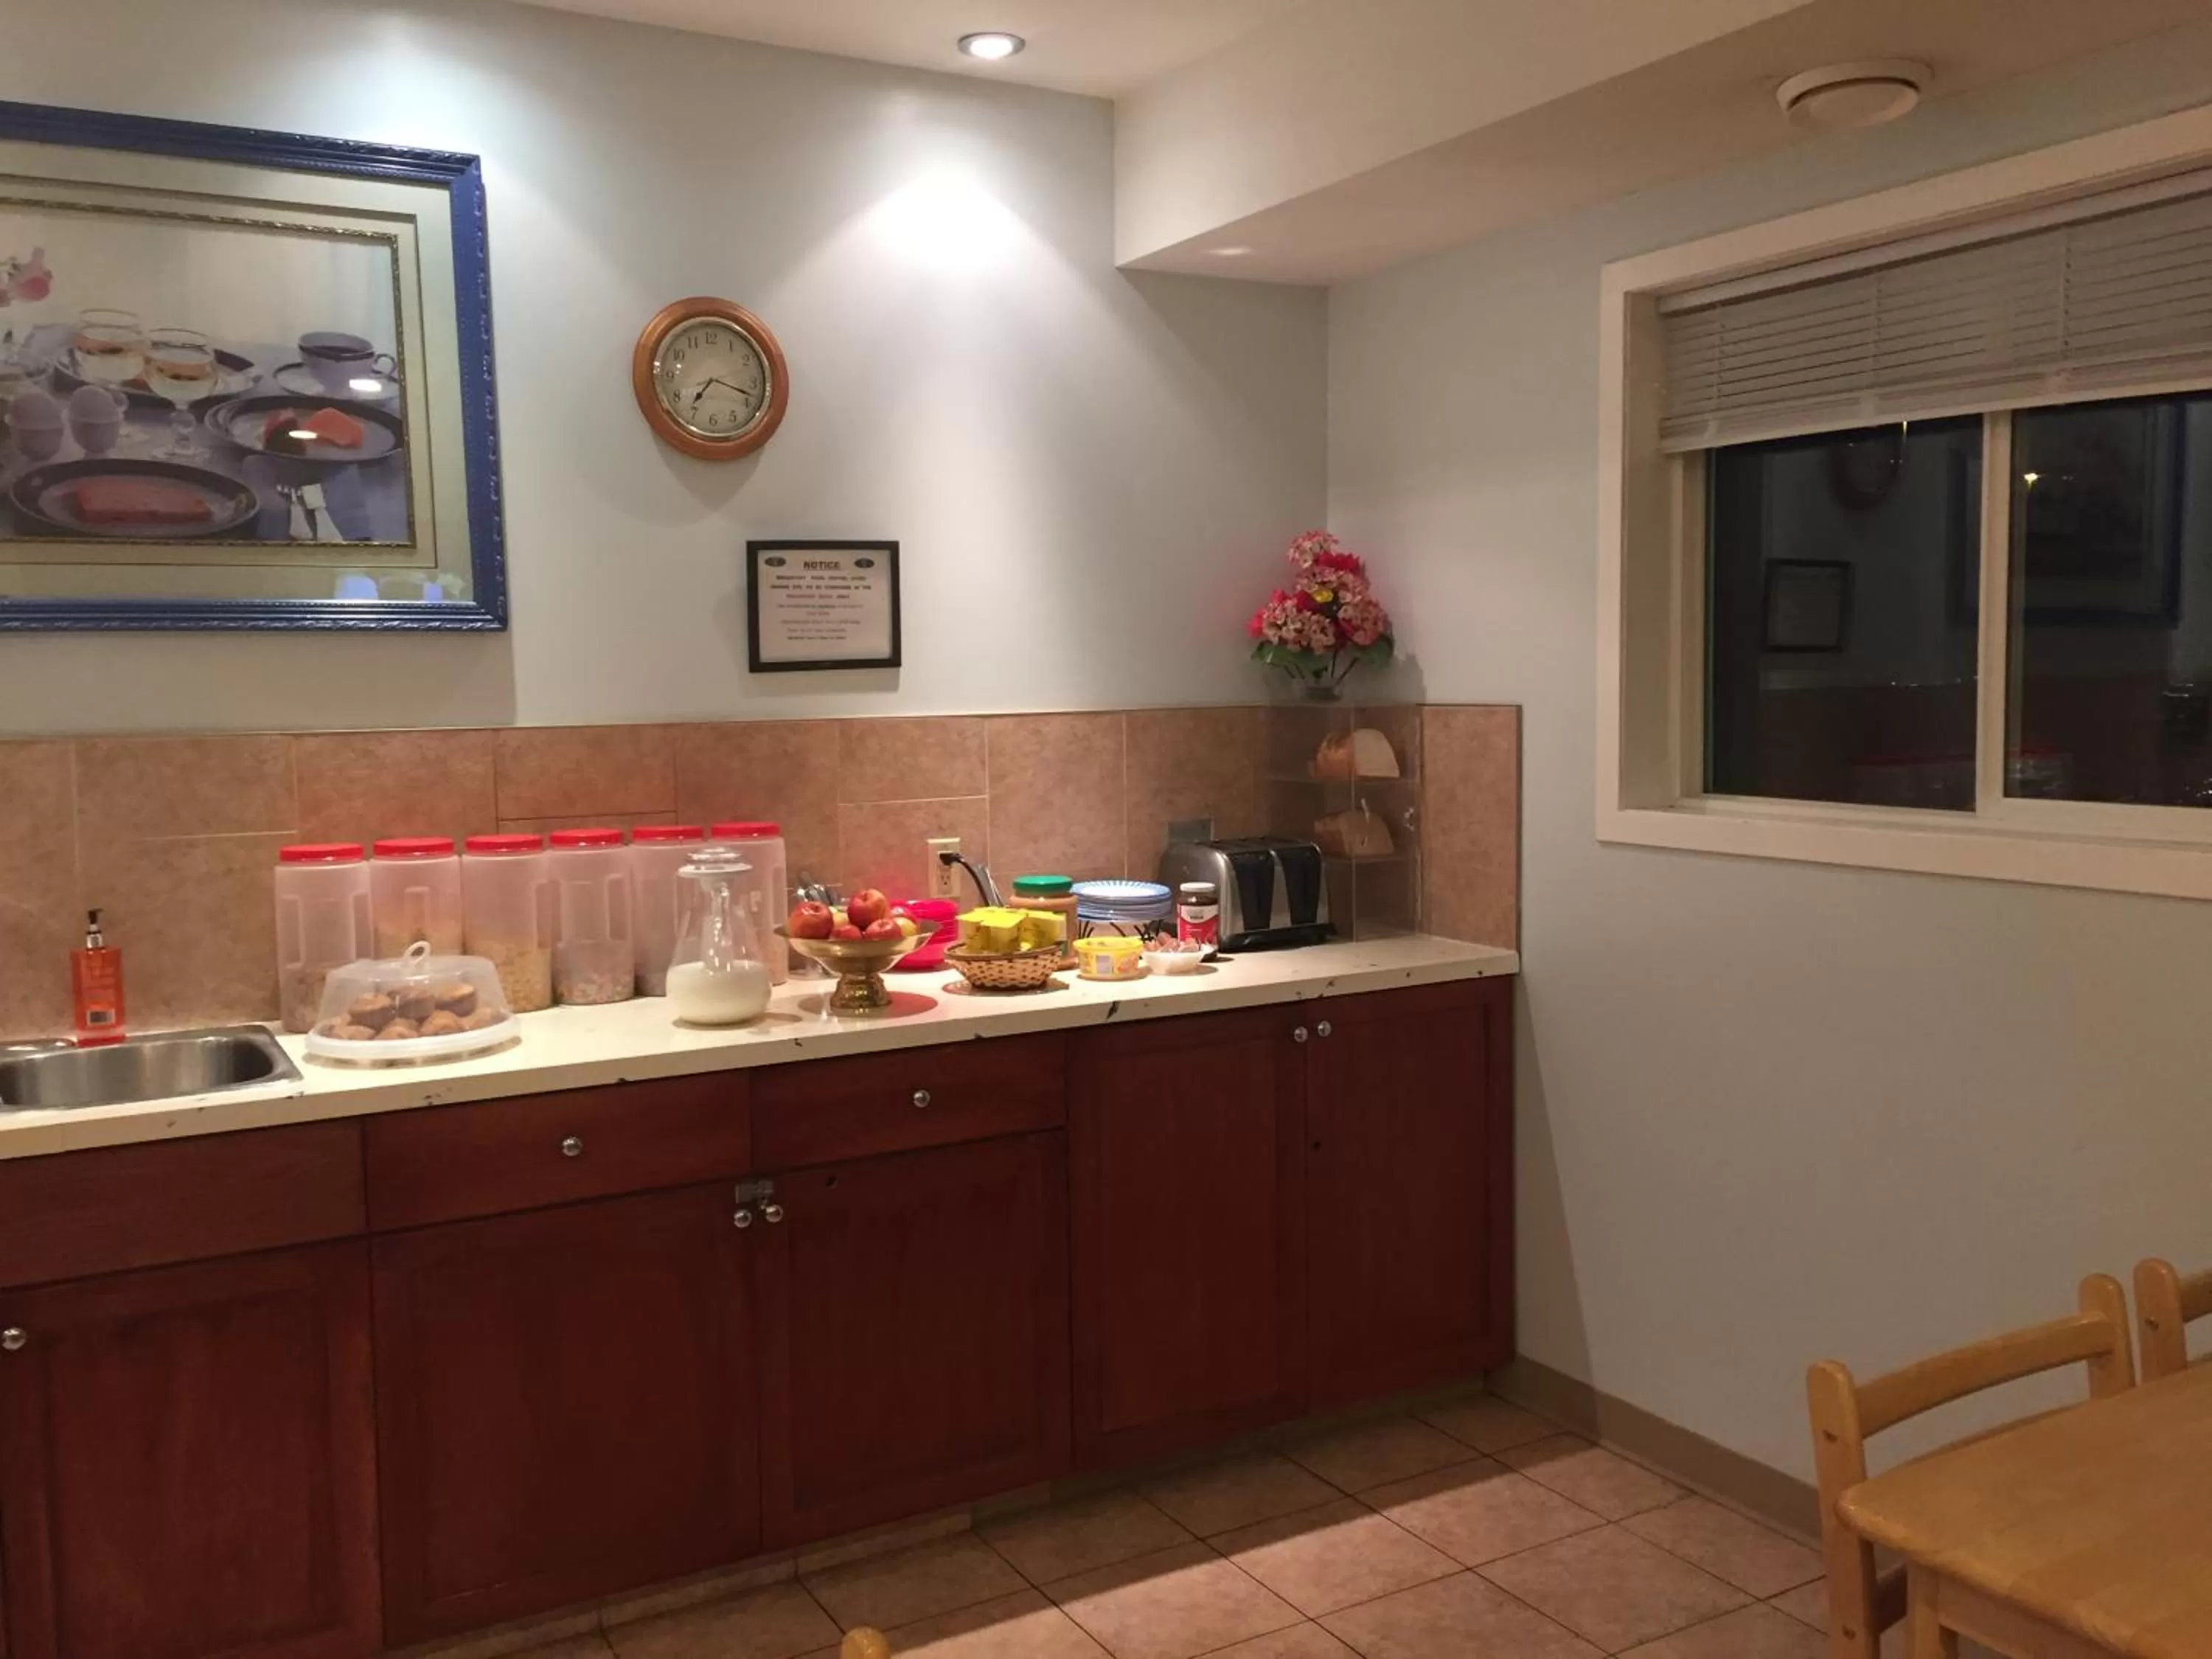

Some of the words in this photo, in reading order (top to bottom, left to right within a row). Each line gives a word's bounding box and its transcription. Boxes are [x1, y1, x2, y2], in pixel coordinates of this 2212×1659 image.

[687, 336, 698, 349] 11
[705, 331, 717, 344] 12
[728, 340, 734, 352] 1
[673, 349, 685, 361] 10
[742, 354, 750, 366] 2
[666, 369, 675, 381] 9
[673, 389, 681, 402] 8
[690, 406, 699, 420] 7
[728, 410, 737, 422] 5
[709, 413, 718, 426] 6
[803, 560, 841, 570] NOTICE
